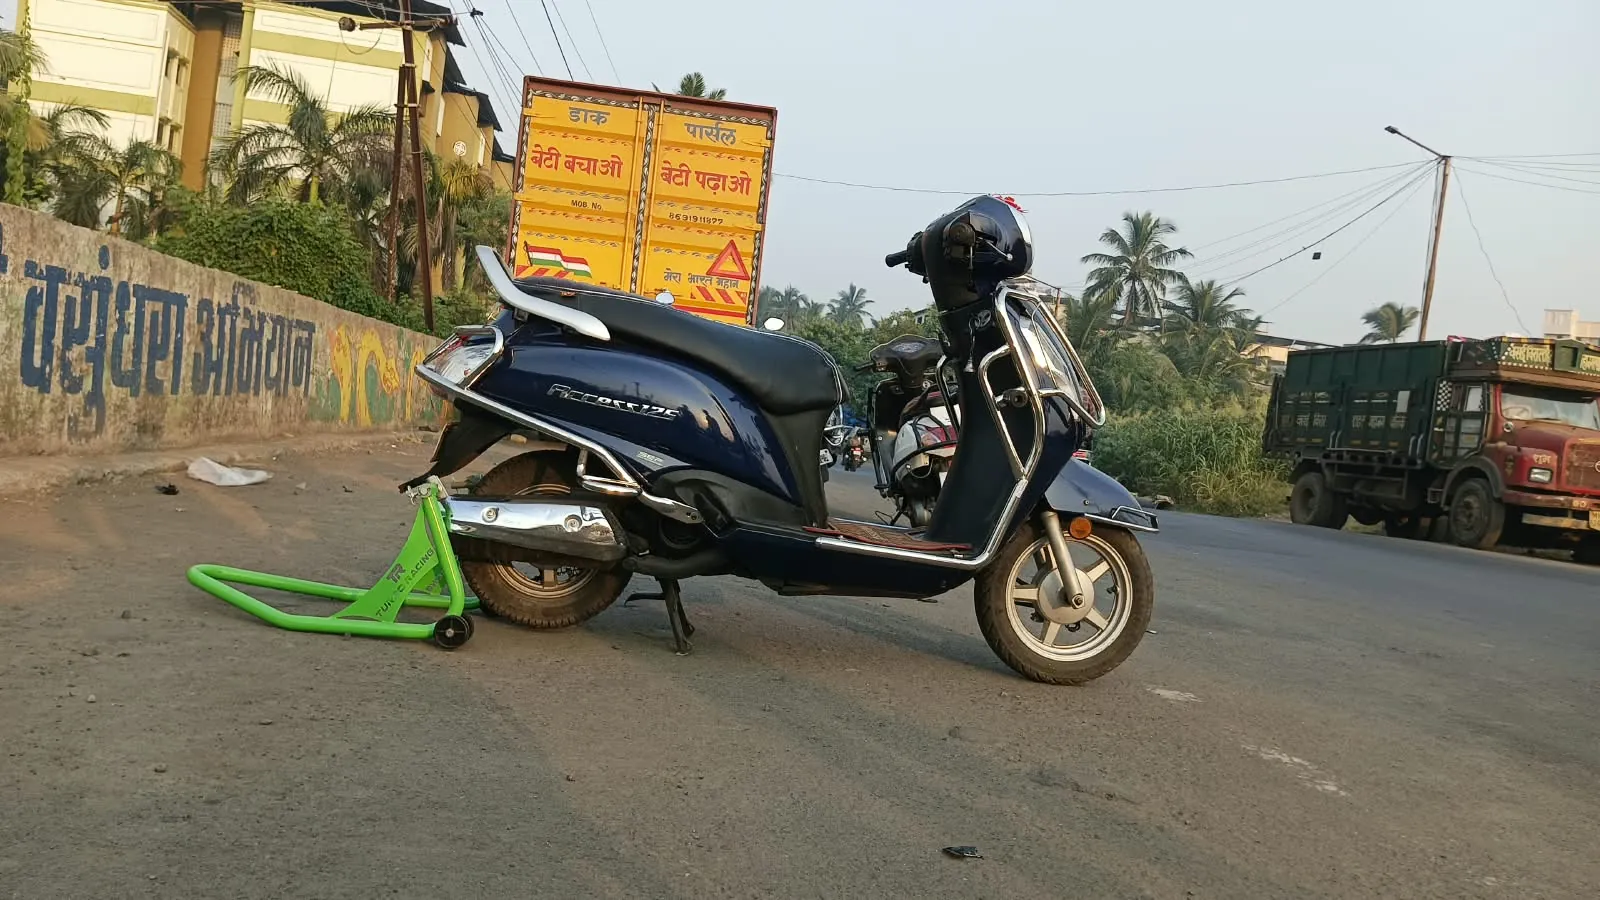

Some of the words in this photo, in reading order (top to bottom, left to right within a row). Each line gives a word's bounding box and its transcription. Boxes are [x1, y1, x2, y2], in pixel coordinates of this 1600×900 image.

[568, 107, 611, 126] डाक
[684, 121, 737, 146] पार्सल
[531, 143, 562, 171] बेटी
[565, 154, 624, 178] बचाओ
[660, 160, 690, 187] बेटी
[688, 272, 713, 287] भारत
